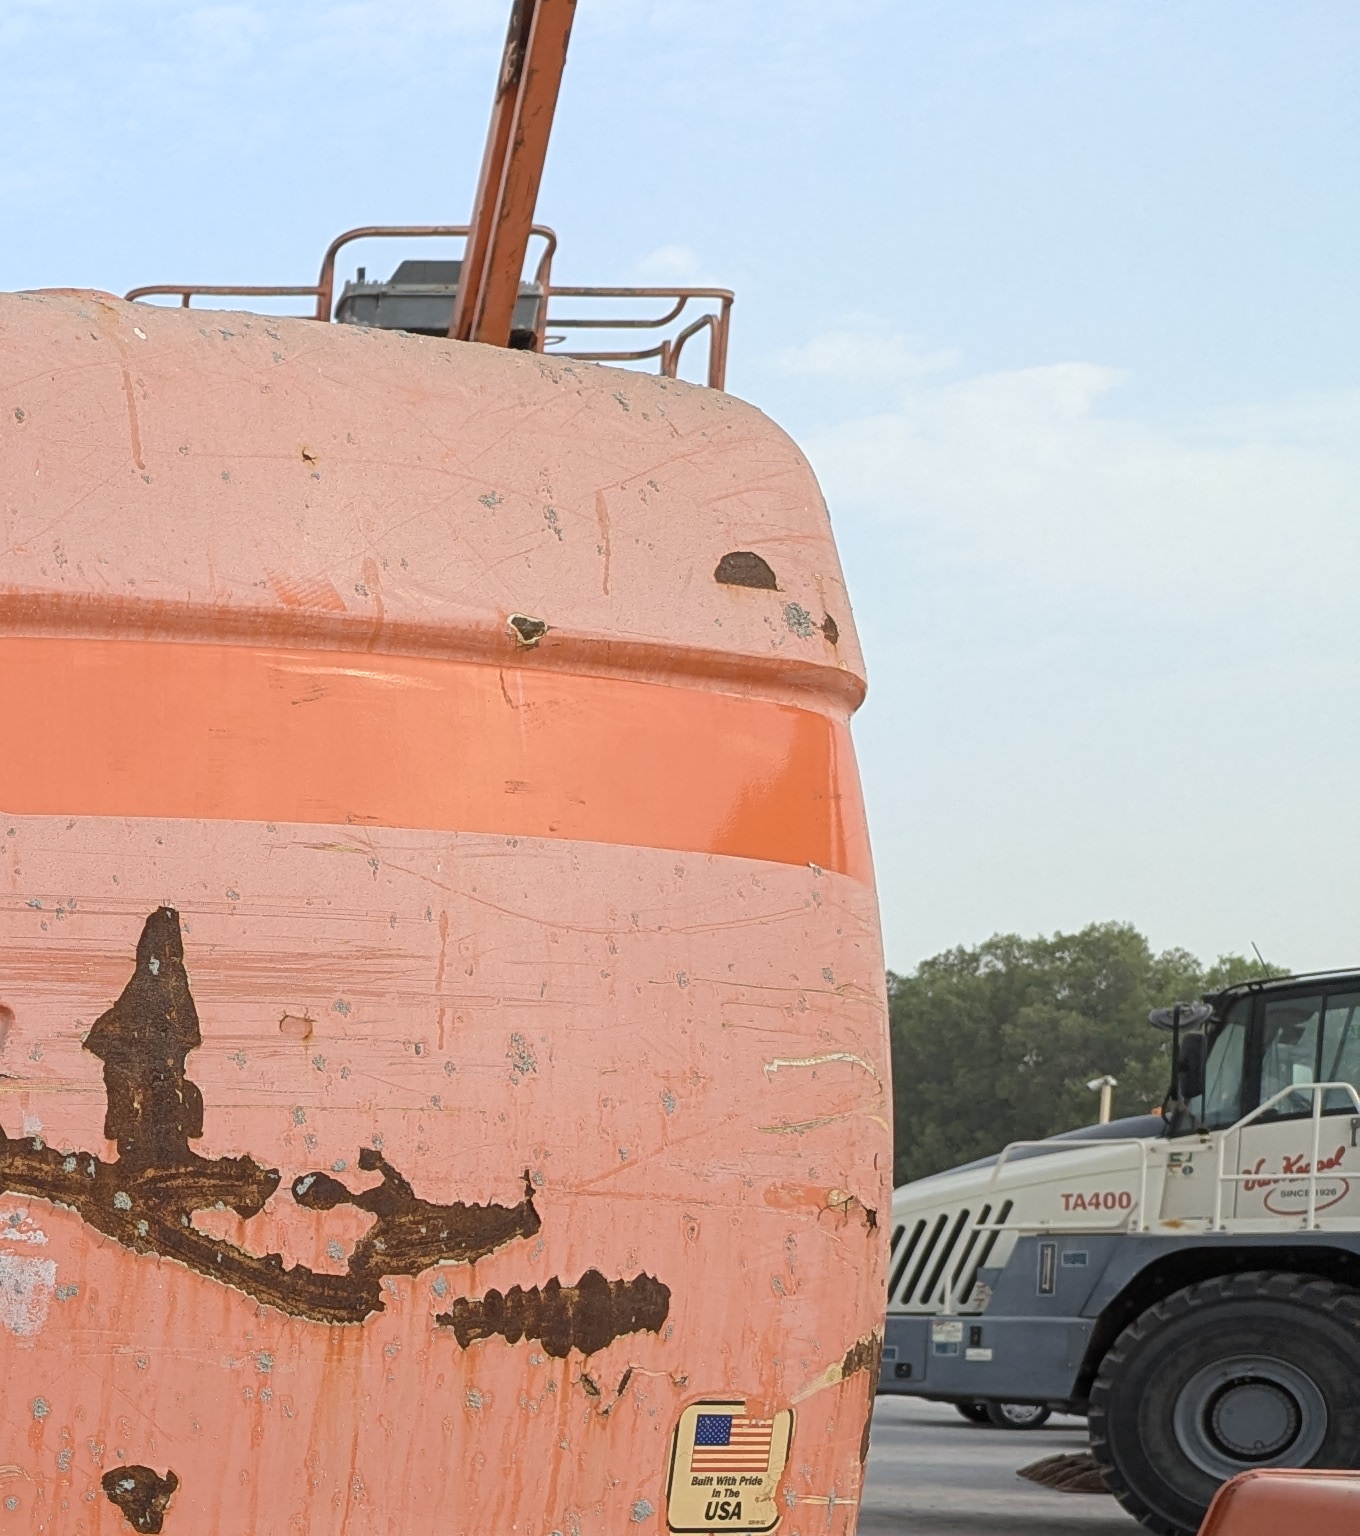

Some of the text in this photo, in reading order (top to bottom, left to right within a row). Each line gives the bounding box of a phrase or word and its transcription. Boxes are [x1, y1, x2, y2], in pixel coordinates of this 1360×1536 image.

[1280, 1189, 1310, 1198] SINCE
[1061, 1192, 1131, 1211] TA400
[691, 1475, 763, 1486] Built With Pride
[724, 1488, 740, 1498] The
[704, 1501, 742, 1521] USA
